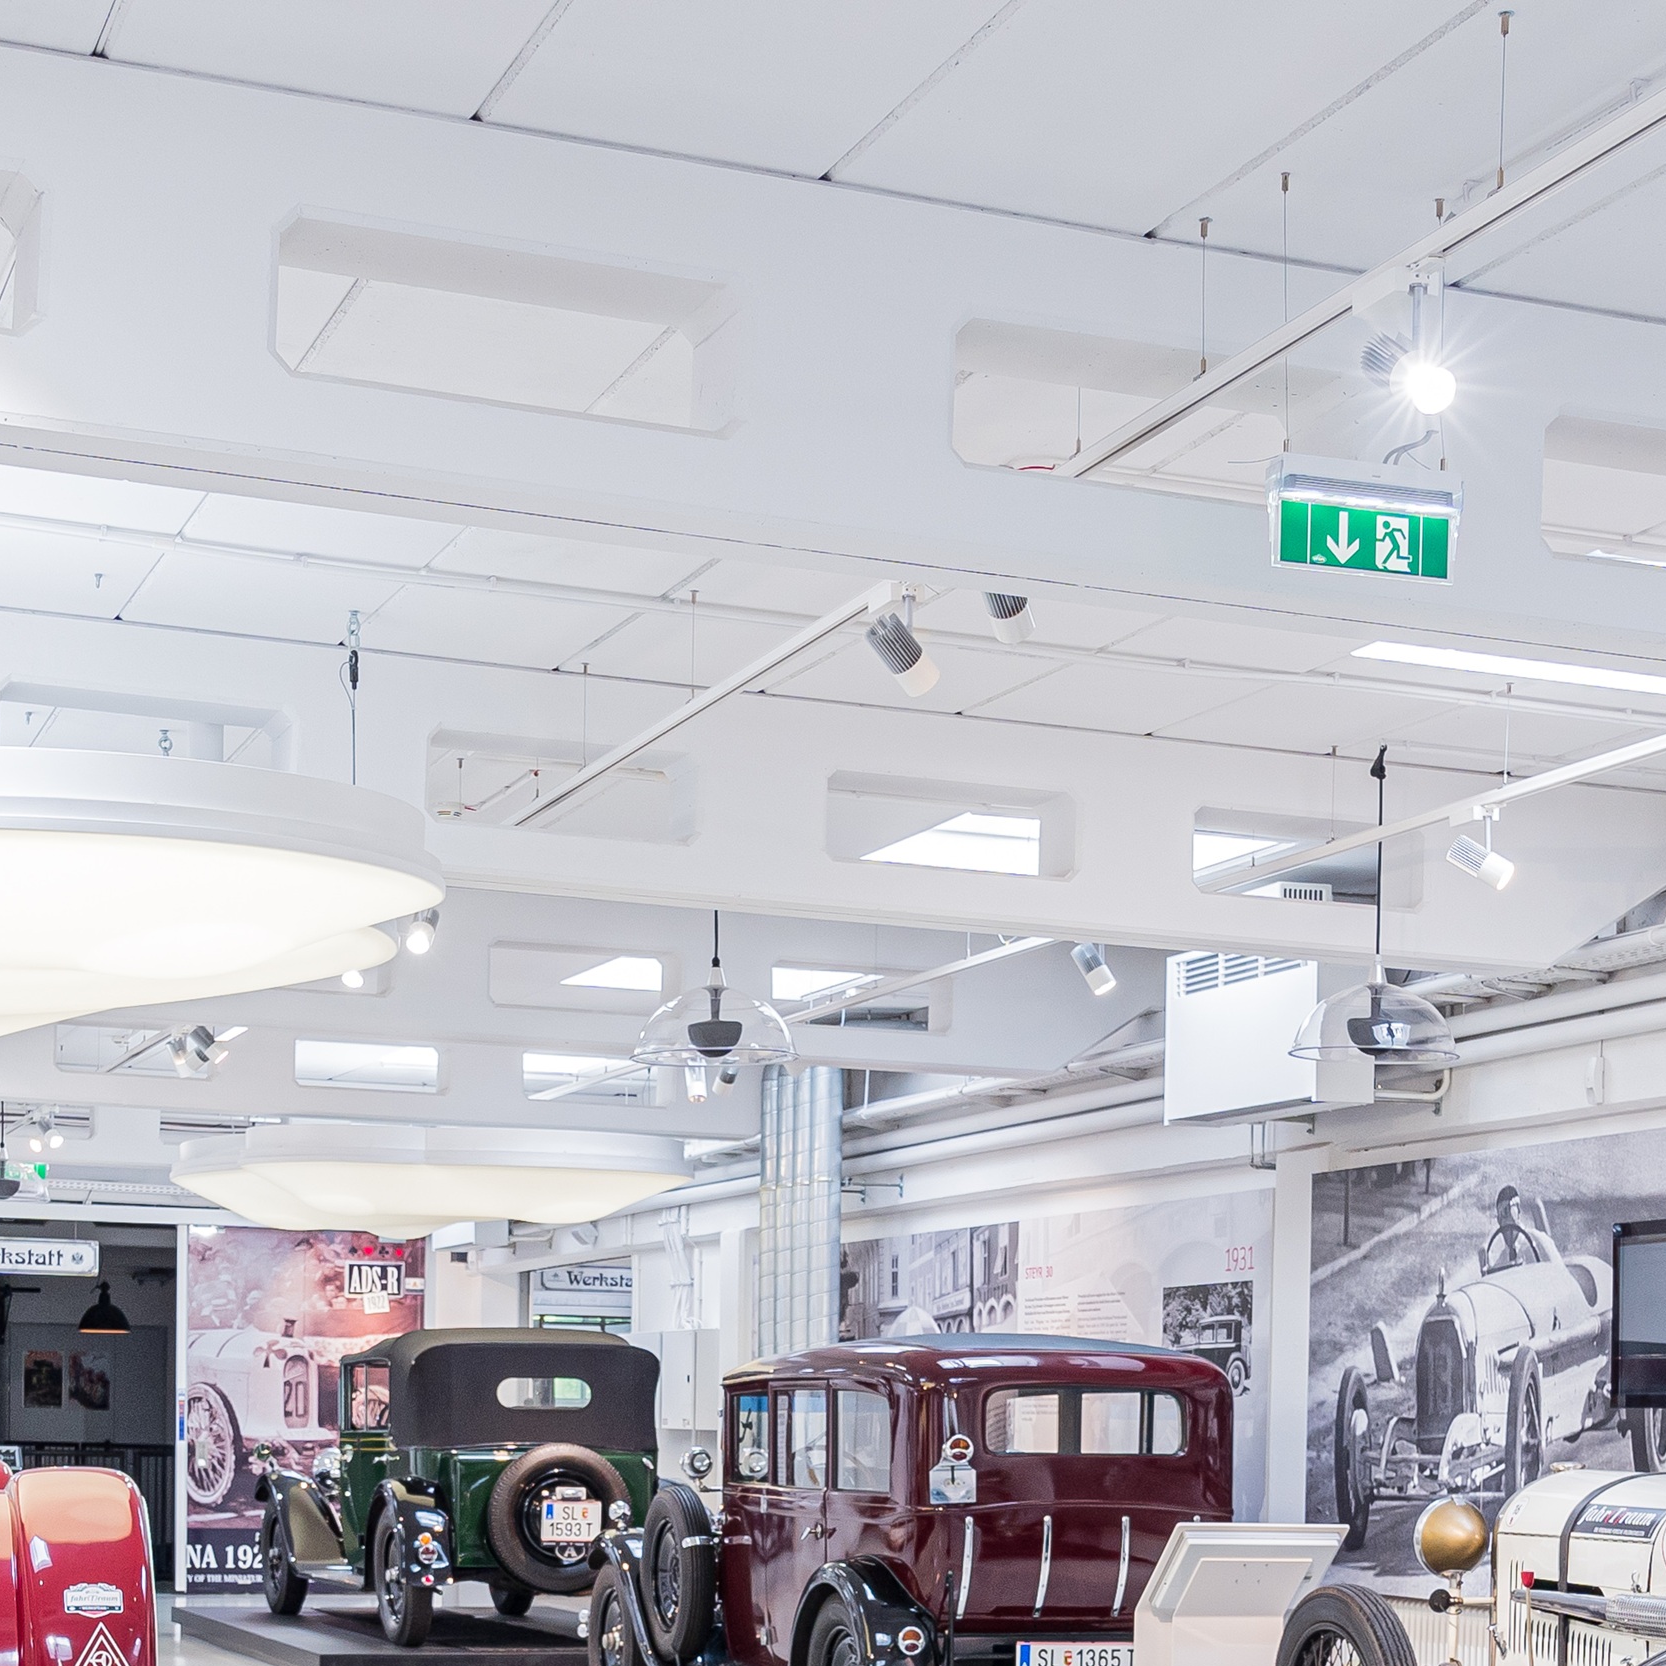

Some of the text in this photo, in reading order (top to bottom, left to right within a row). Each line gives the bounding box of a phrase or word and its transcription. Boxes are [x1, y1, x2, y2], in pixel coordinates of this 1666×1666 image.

[1225, 1246, 1255, 1272] 1931
[349, 1265, 399, 1294] ADS-R
[1025, 1267, 1043, 1280] STEYR
[562, 1506, 577, 1520] SL
[550, 1523, 593, 1536] 1593 T
